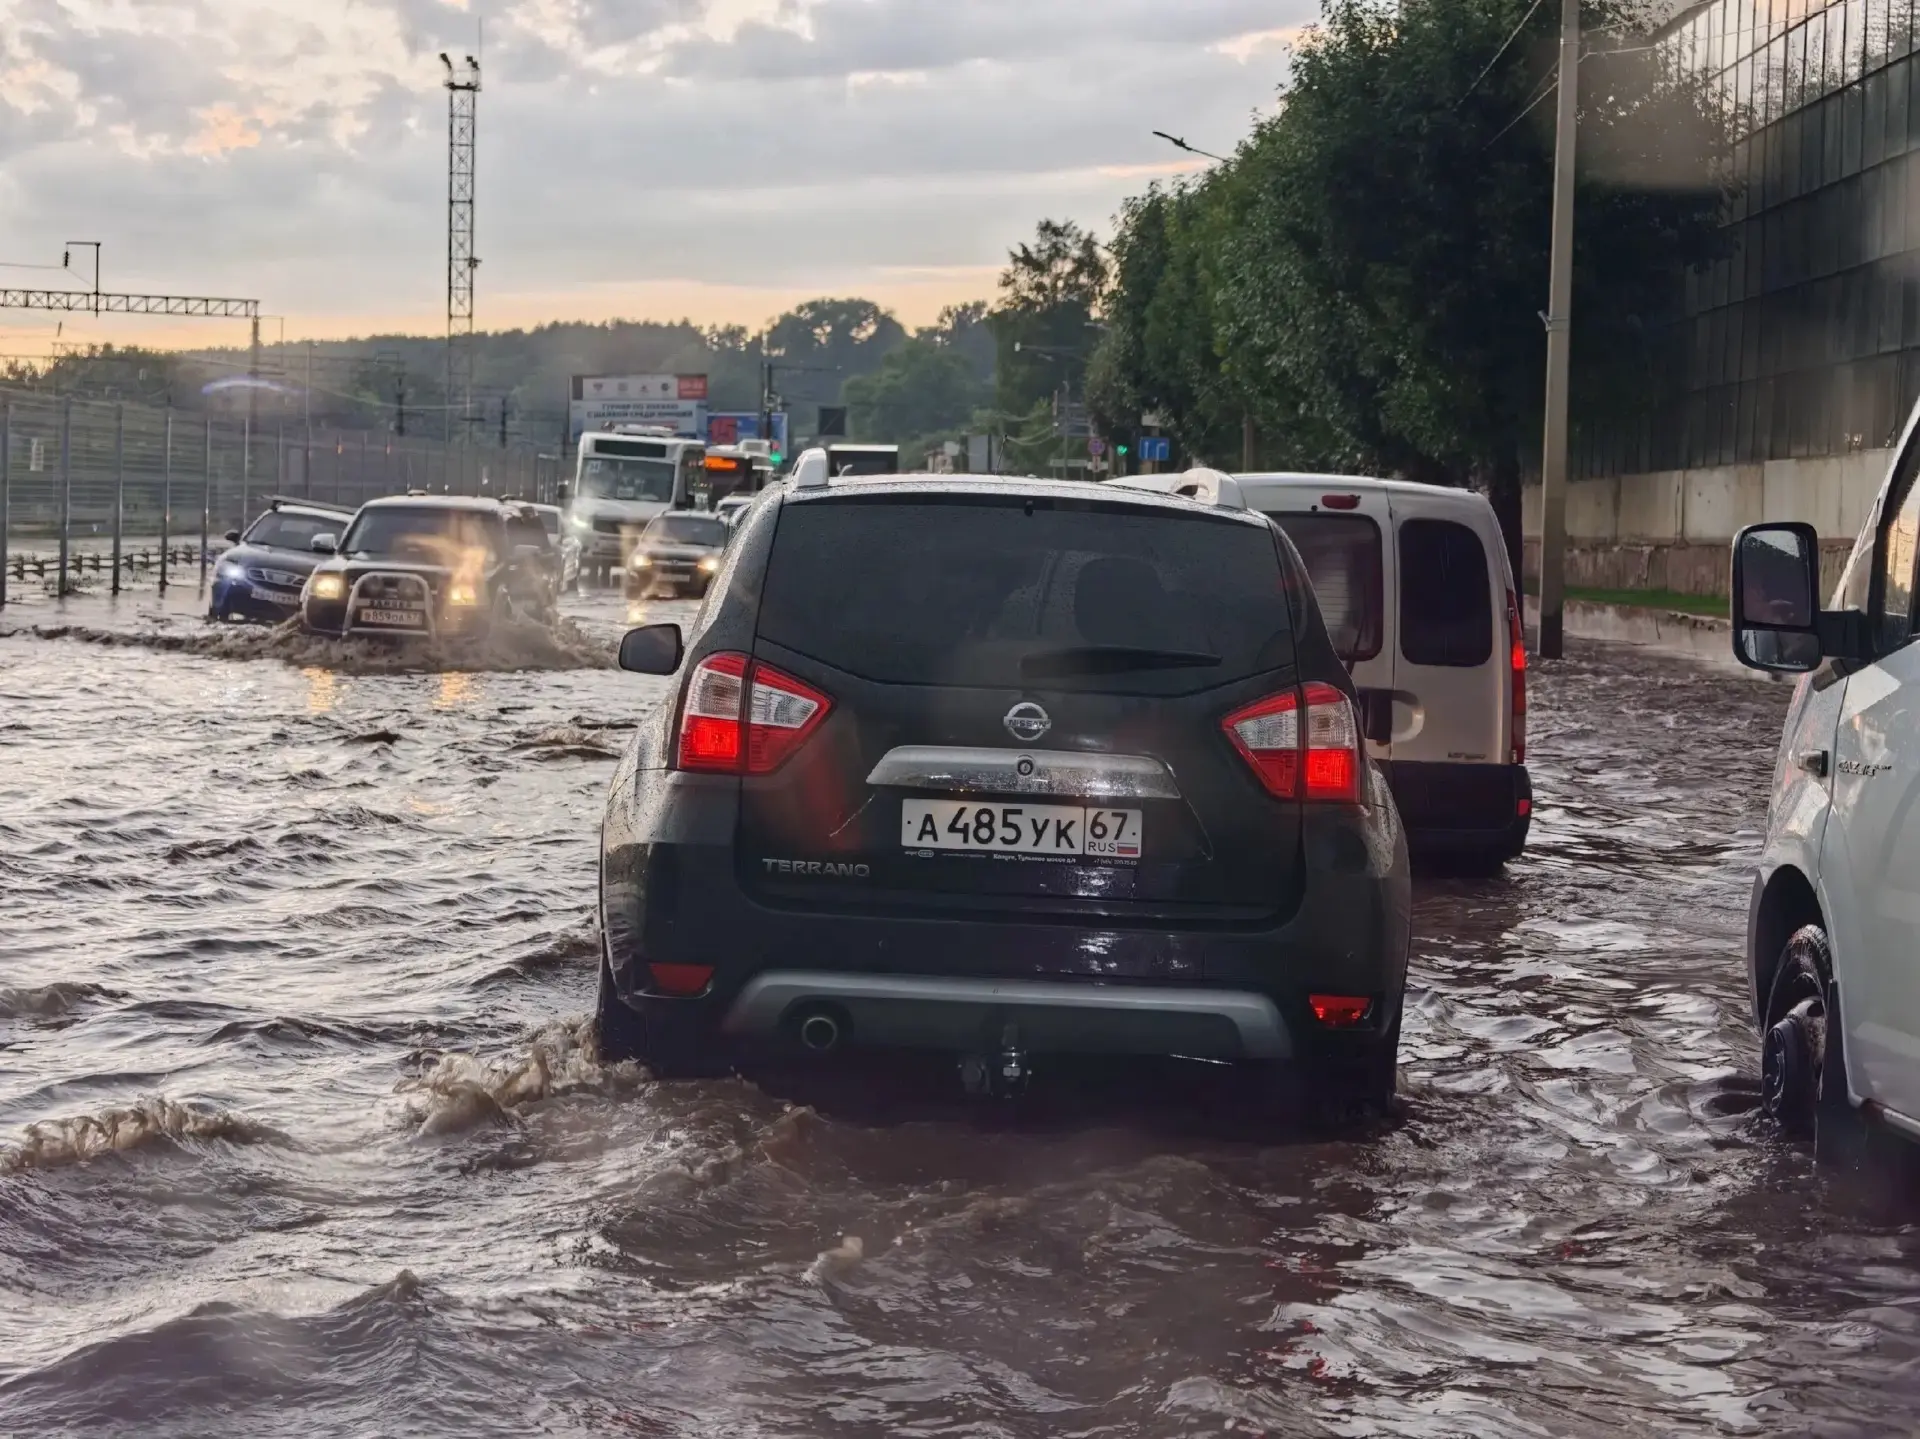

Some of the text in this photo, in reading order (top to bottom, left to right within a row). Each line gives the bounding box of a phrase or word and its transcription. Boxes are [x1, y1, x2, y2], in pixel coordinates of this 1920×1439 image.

[916, 806, 1076, 849] А485УК
[1089, 810, 1128, 841] 67
[1088, 841, 1116, 853] RUS
[762, 858, 870, 877] TERRANO
